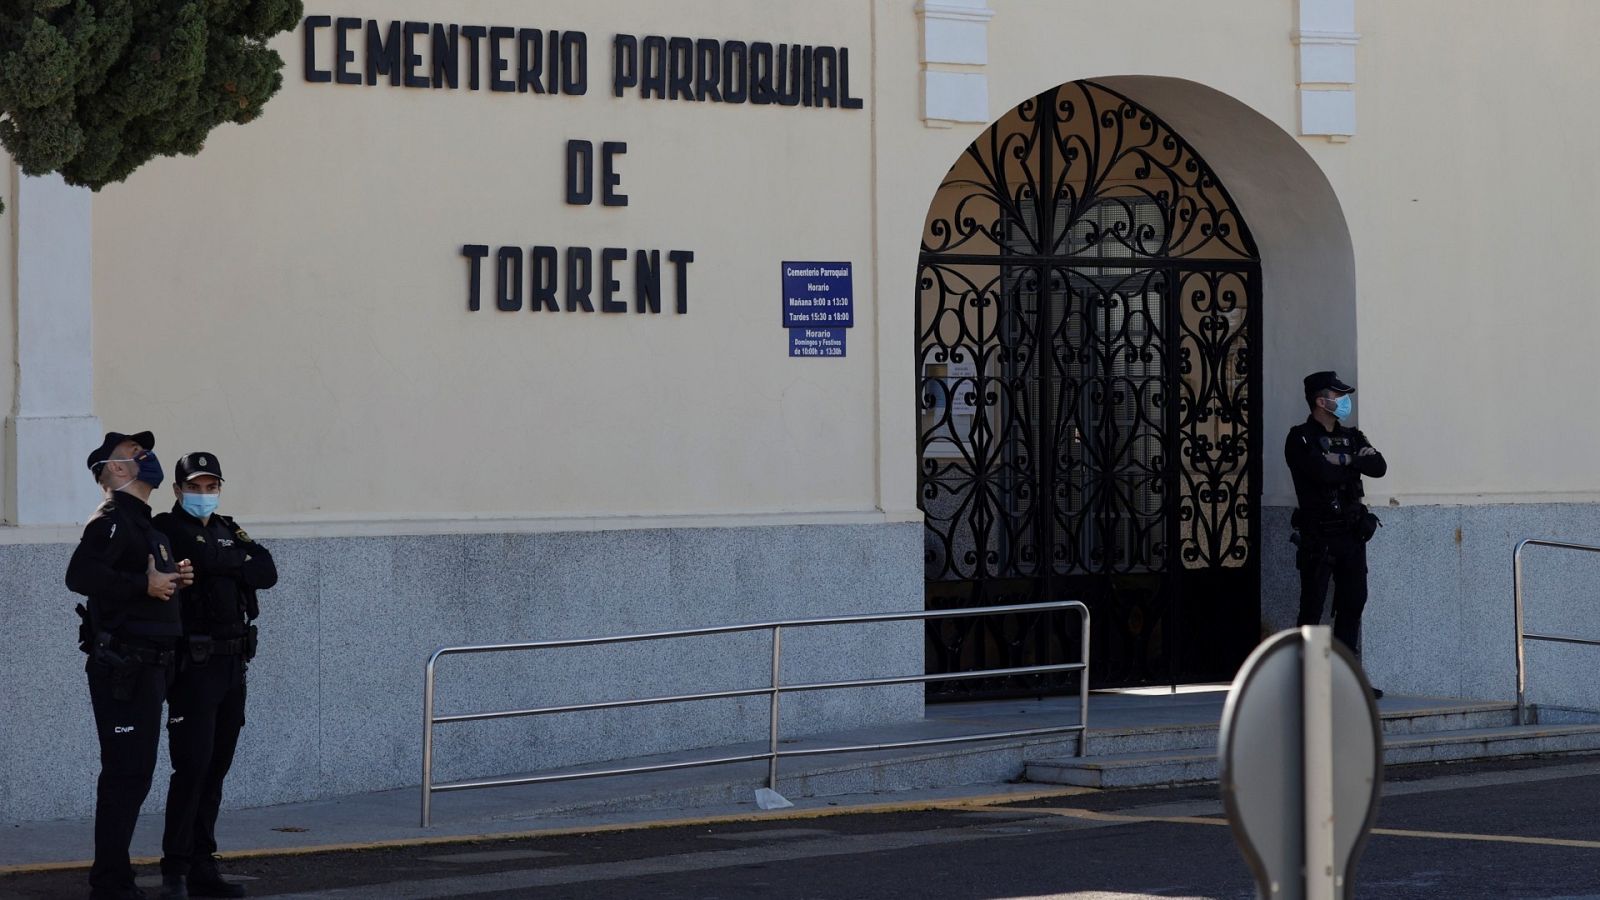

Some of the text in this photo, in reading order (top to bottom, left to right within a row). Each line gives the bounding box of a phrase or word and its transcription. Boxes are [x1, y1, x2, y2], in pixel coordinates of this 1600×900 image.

[304, 15, 864, 109] CEMENTERIO PARROQUIAL
[566, 139, 629, 207] DE
[787, 268, 848, 278] Cementerio Parroquial
[462, 244, 695, 315] TORRENT
[807, 283, 830, 291] Horario
[789, 298, 812, 306] Mañana
[813, 298, 826, 306] 9:00
[832, 298, 848, 306] 13:30
[805, 330, 831, 338] Horario
